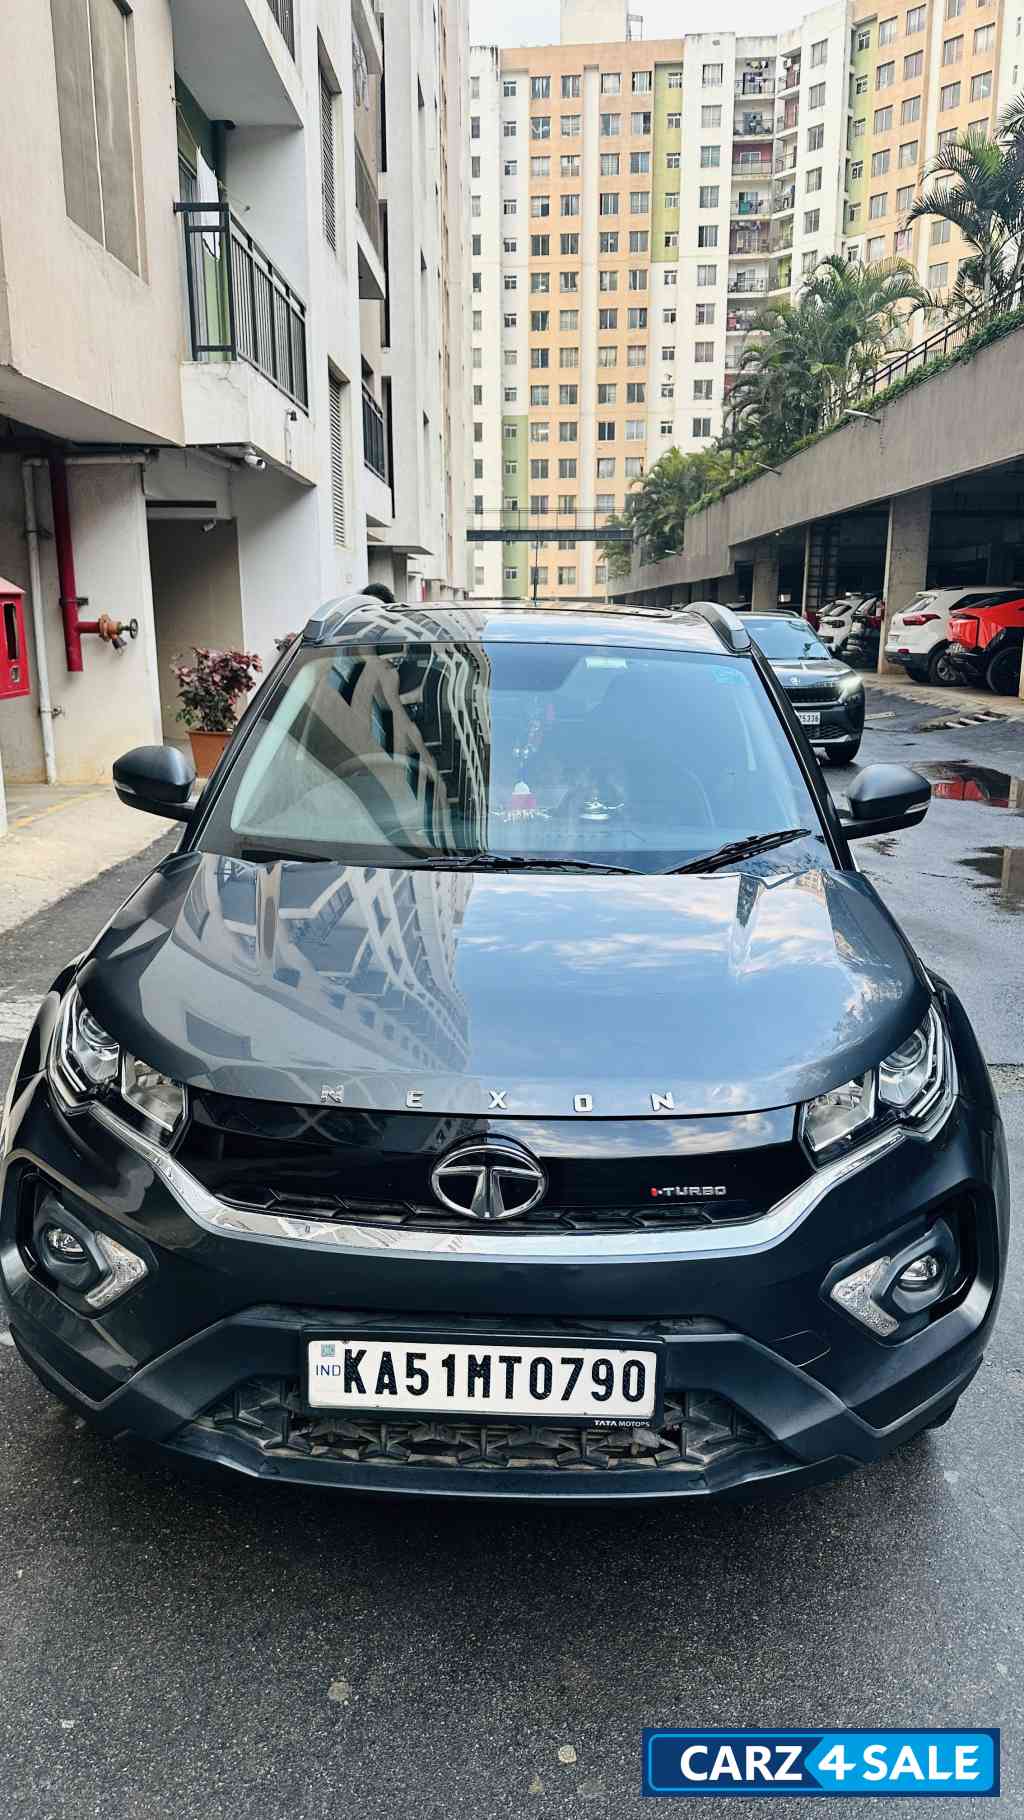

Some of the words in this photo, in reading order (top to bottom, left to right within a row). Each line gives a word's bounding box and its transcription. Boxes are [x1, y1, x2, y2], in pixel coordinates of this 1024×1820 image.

[320, 1084, 675, 1112] NEXON
[315, 1364, 341, 1377] IND
[343, 1348, 646, 1403] KA51MT0790
[618, 1420, 650, 1428] MOTORS
